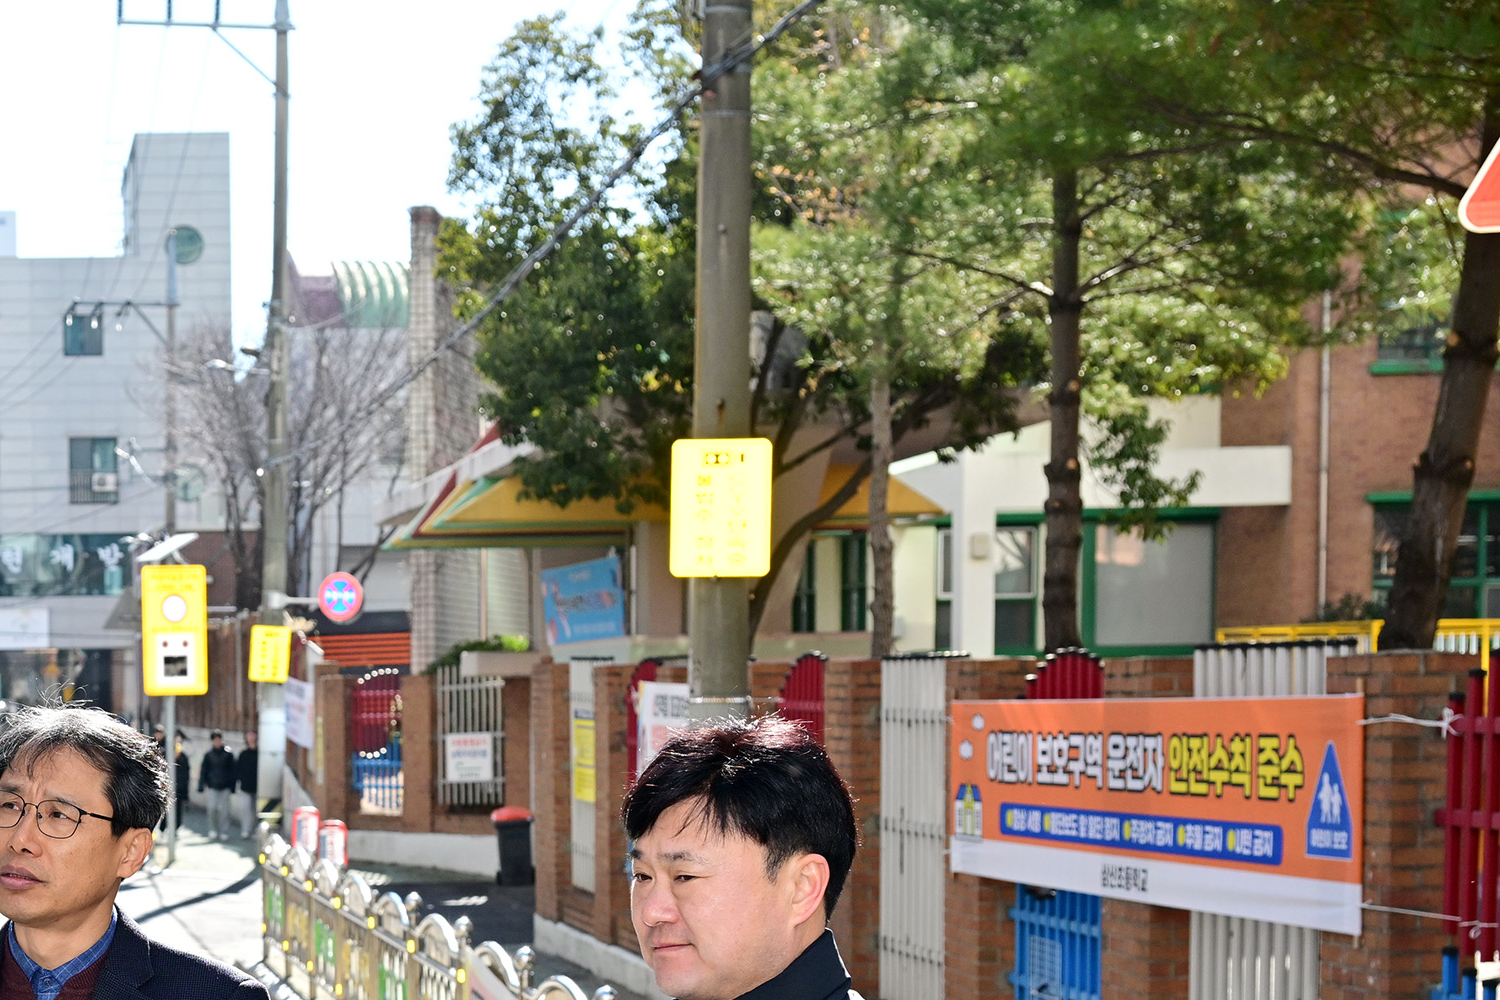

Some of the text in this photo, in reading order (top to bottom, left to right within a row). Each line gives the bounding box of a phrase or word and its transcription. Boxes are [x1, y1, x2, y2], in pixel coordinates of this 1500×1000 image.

[987, 731, 1304, 802] 어린이 보호구역 운전자 안전수칙 준수
[1155, 821, 1174, 847] 금지
[1185, 823, 1203, 850] 추월
[1204, 825, 1223, 852] 금지
[1253, 829, 1274, 858] 금지
